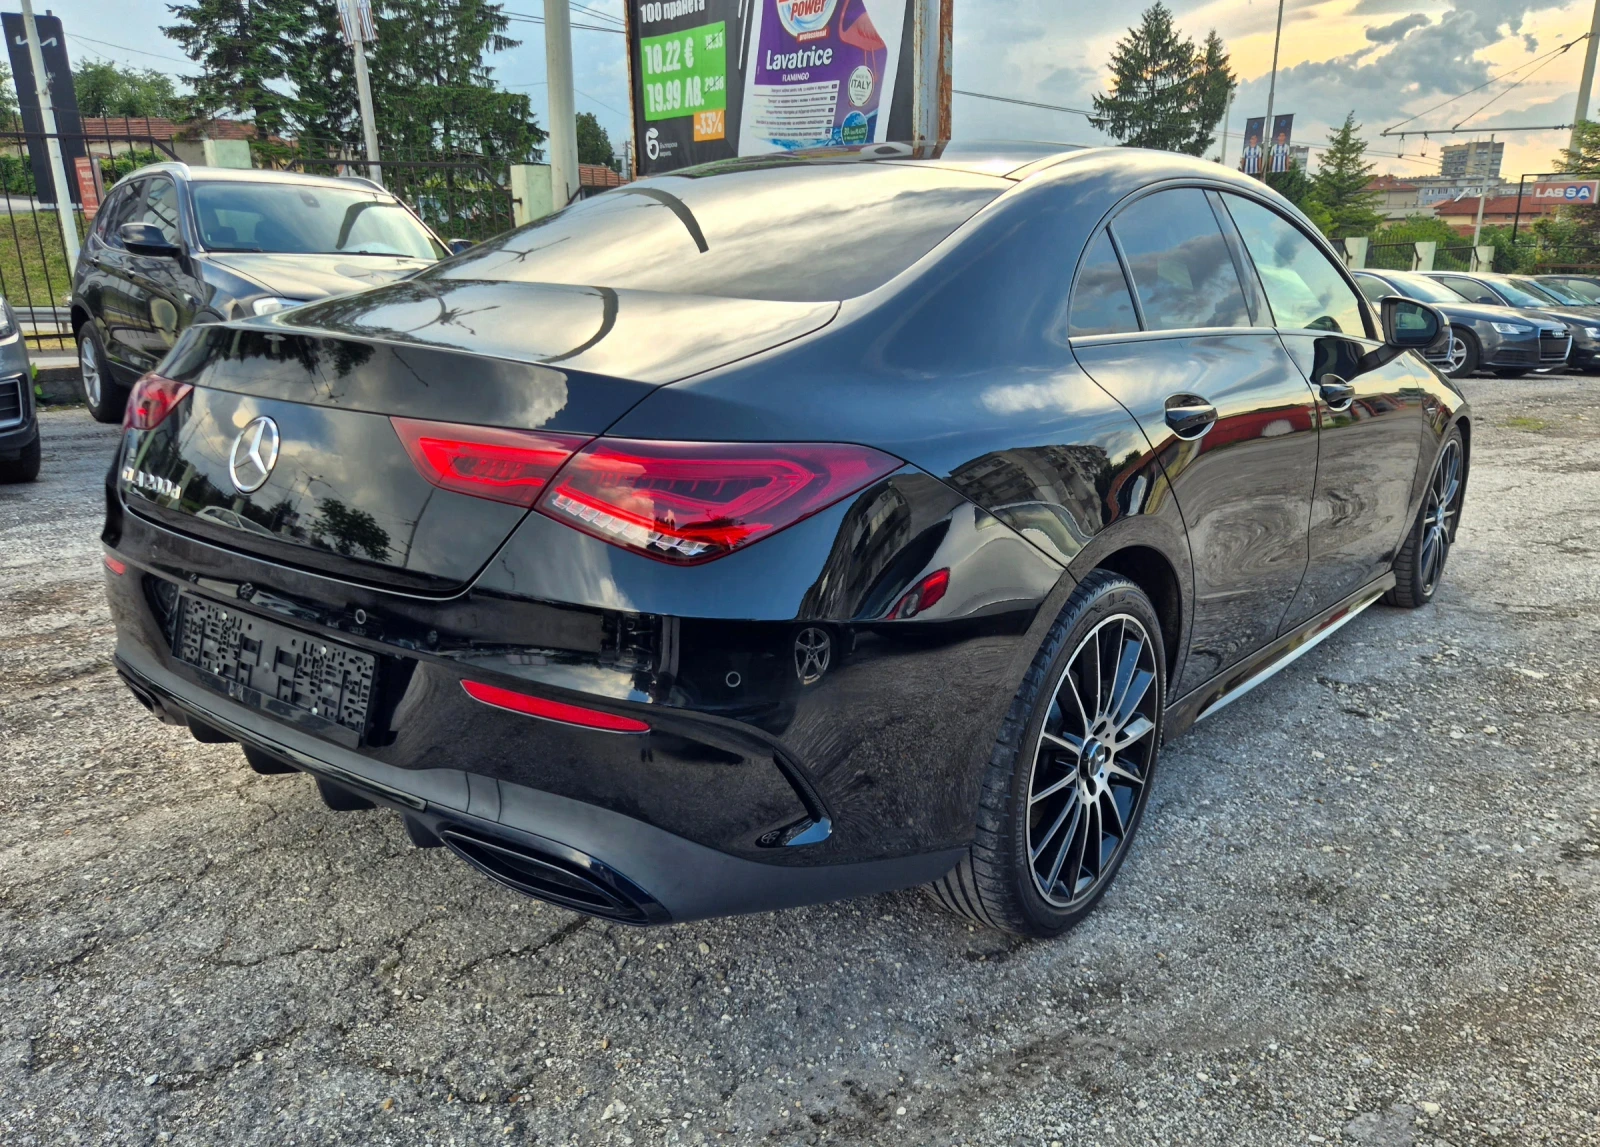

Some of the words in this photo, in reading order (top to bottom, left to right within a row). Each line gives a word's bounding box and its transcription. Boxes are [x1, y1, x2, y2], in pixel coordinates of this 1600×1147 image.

[640, 2, 662, 23] 100
[644, 39, 682, 75] 10.22
[683, 36, 695, 69] €
[766, 45, 833, 71] Lavatrice
[782, 71, 810, 82] FLAMINGO
[850, 79, 872, 90] ITALY
[646, 79, 682, 113] 19.99
[695, 111, 723, 135] -33%
[1535, 187, 1590, 198] LASSA
